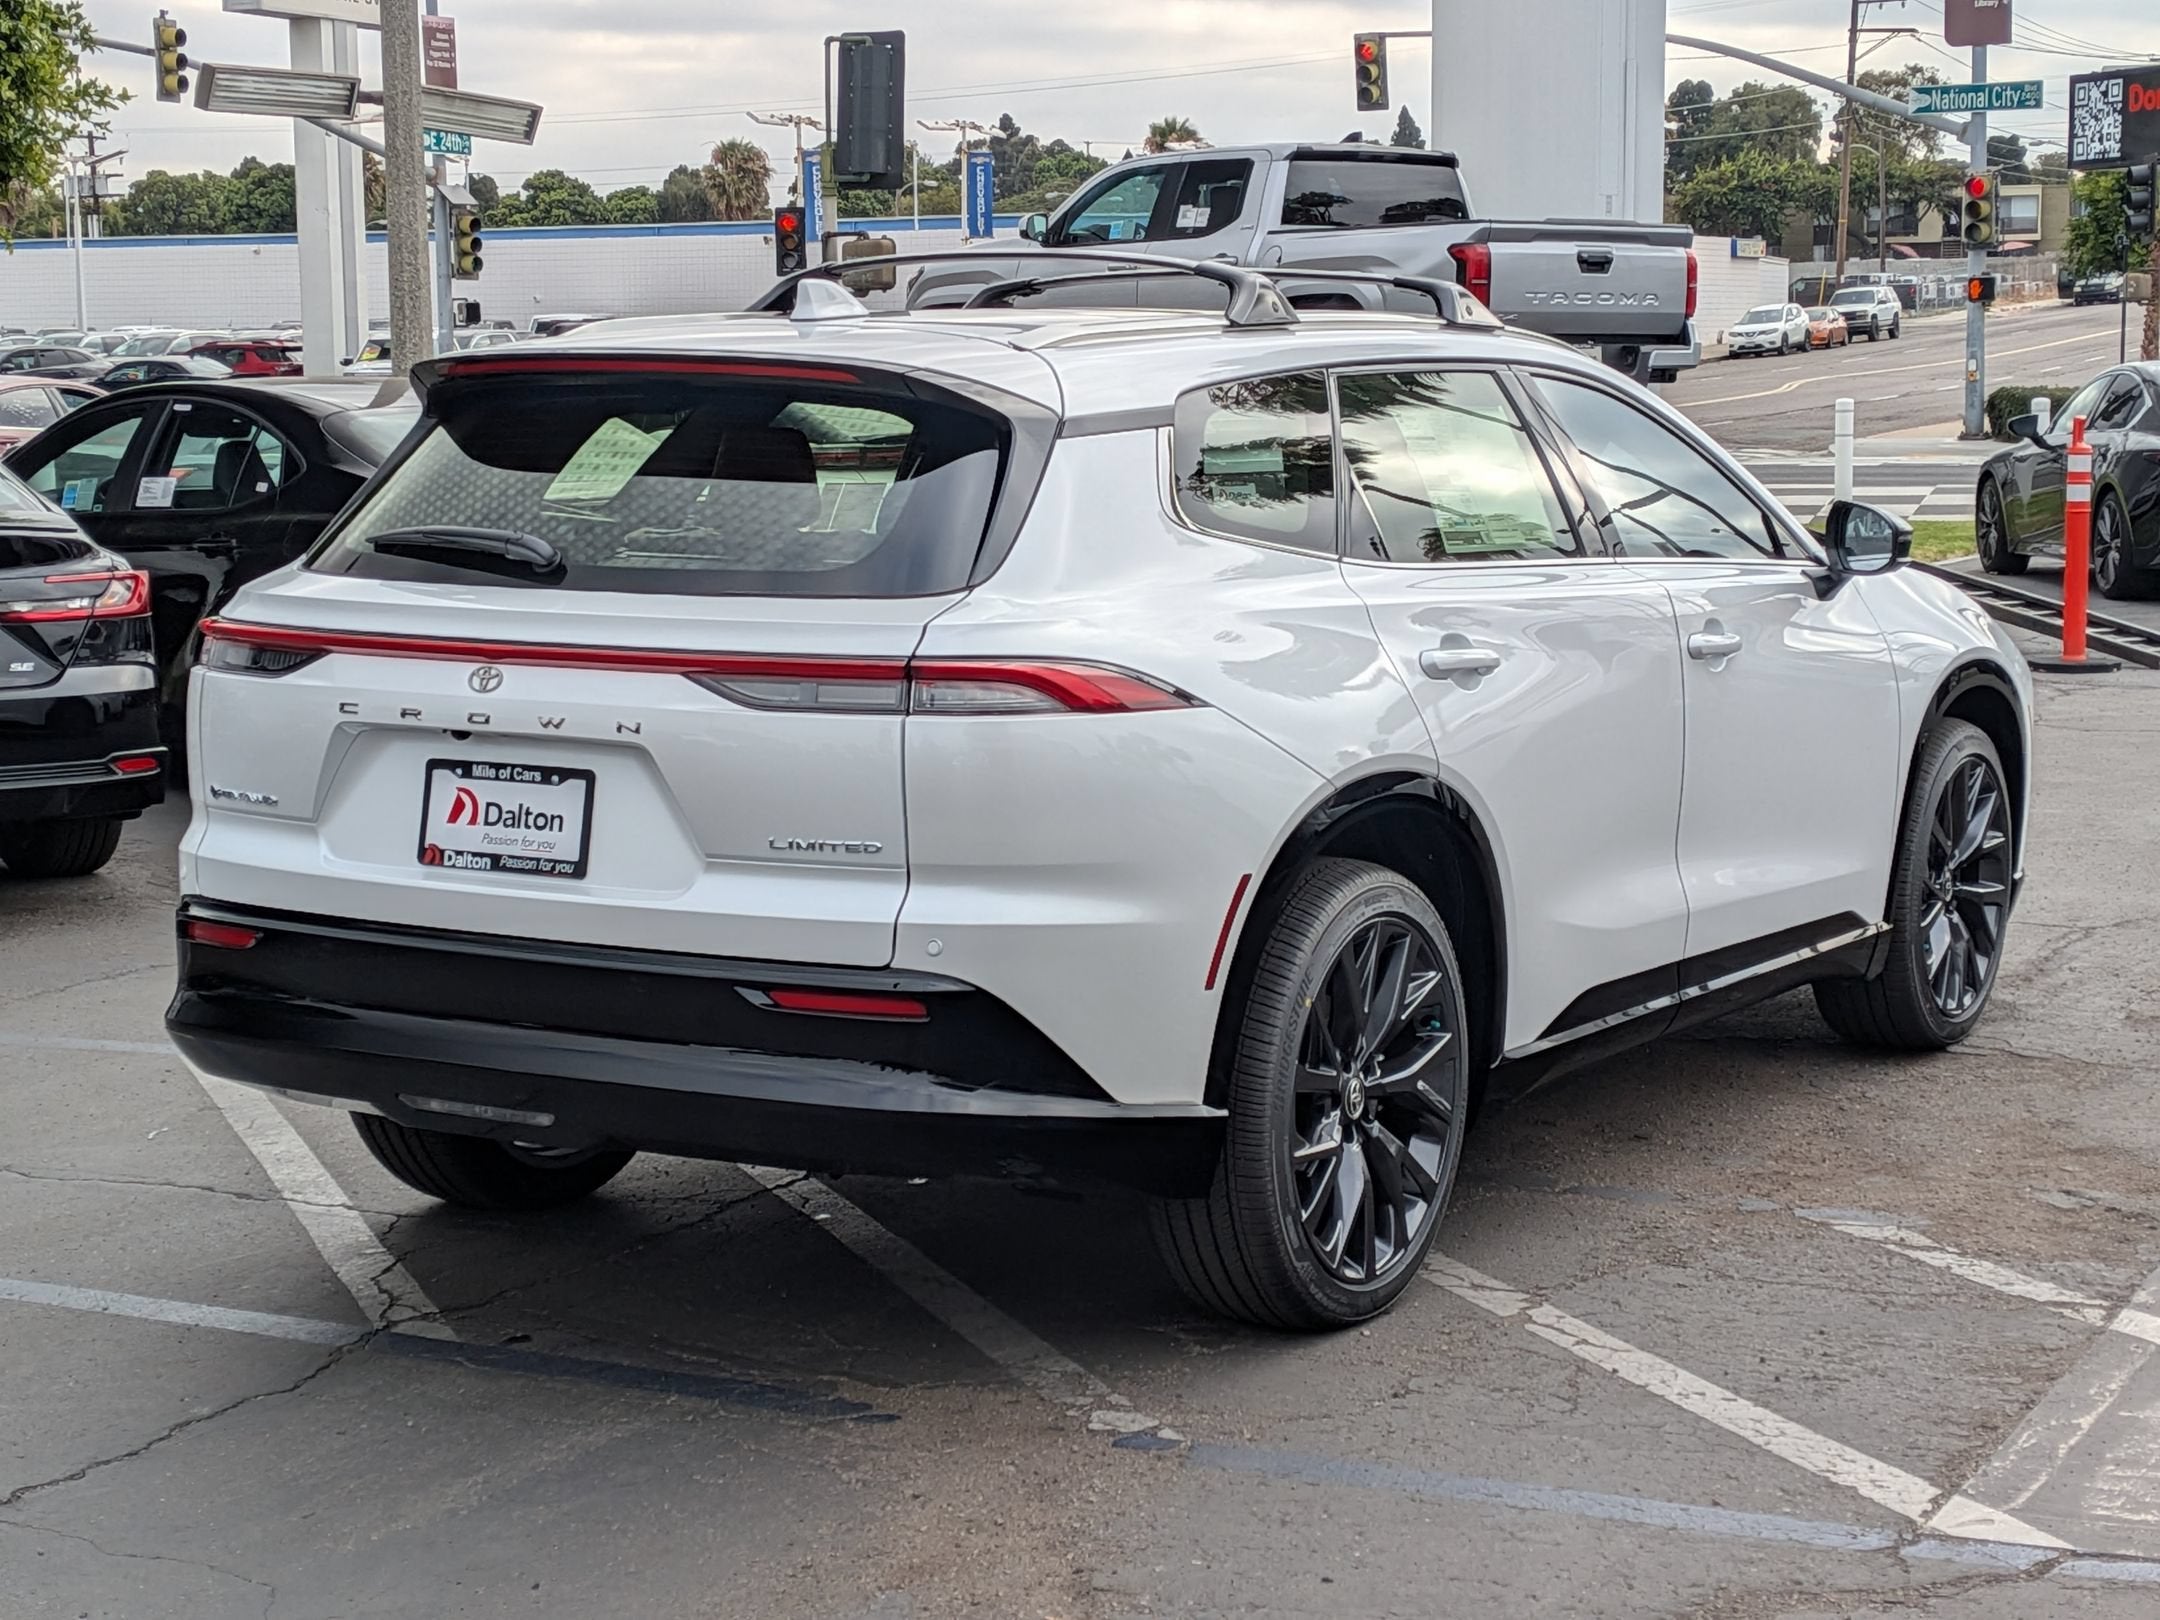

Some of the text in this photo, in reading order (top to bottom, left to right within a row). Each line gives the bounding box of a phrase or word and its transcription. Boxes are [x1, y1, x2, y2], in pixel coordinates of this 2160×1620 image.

[1931, 88, 1989, 111] National
[1991, 85, 2021, 108] City
[2129, 83, 2160, 112] Do
[430, 130, 440, 150] E
[440, 131, 462, 152] 24th
[1525, 291, 1660, 306] TACOMA
[9, 662, 35, 671] SE
[338, 702, 642, 735] CROWN
[472, 763, 541, 782] Mile of Cars
[483, 801, 564, 832] Dalton
[481, 833, 556, 850] Passion for you
[768, 836, 883, 854] LIMITED
[443, 850, 575, 874] Dalton Passion for you
